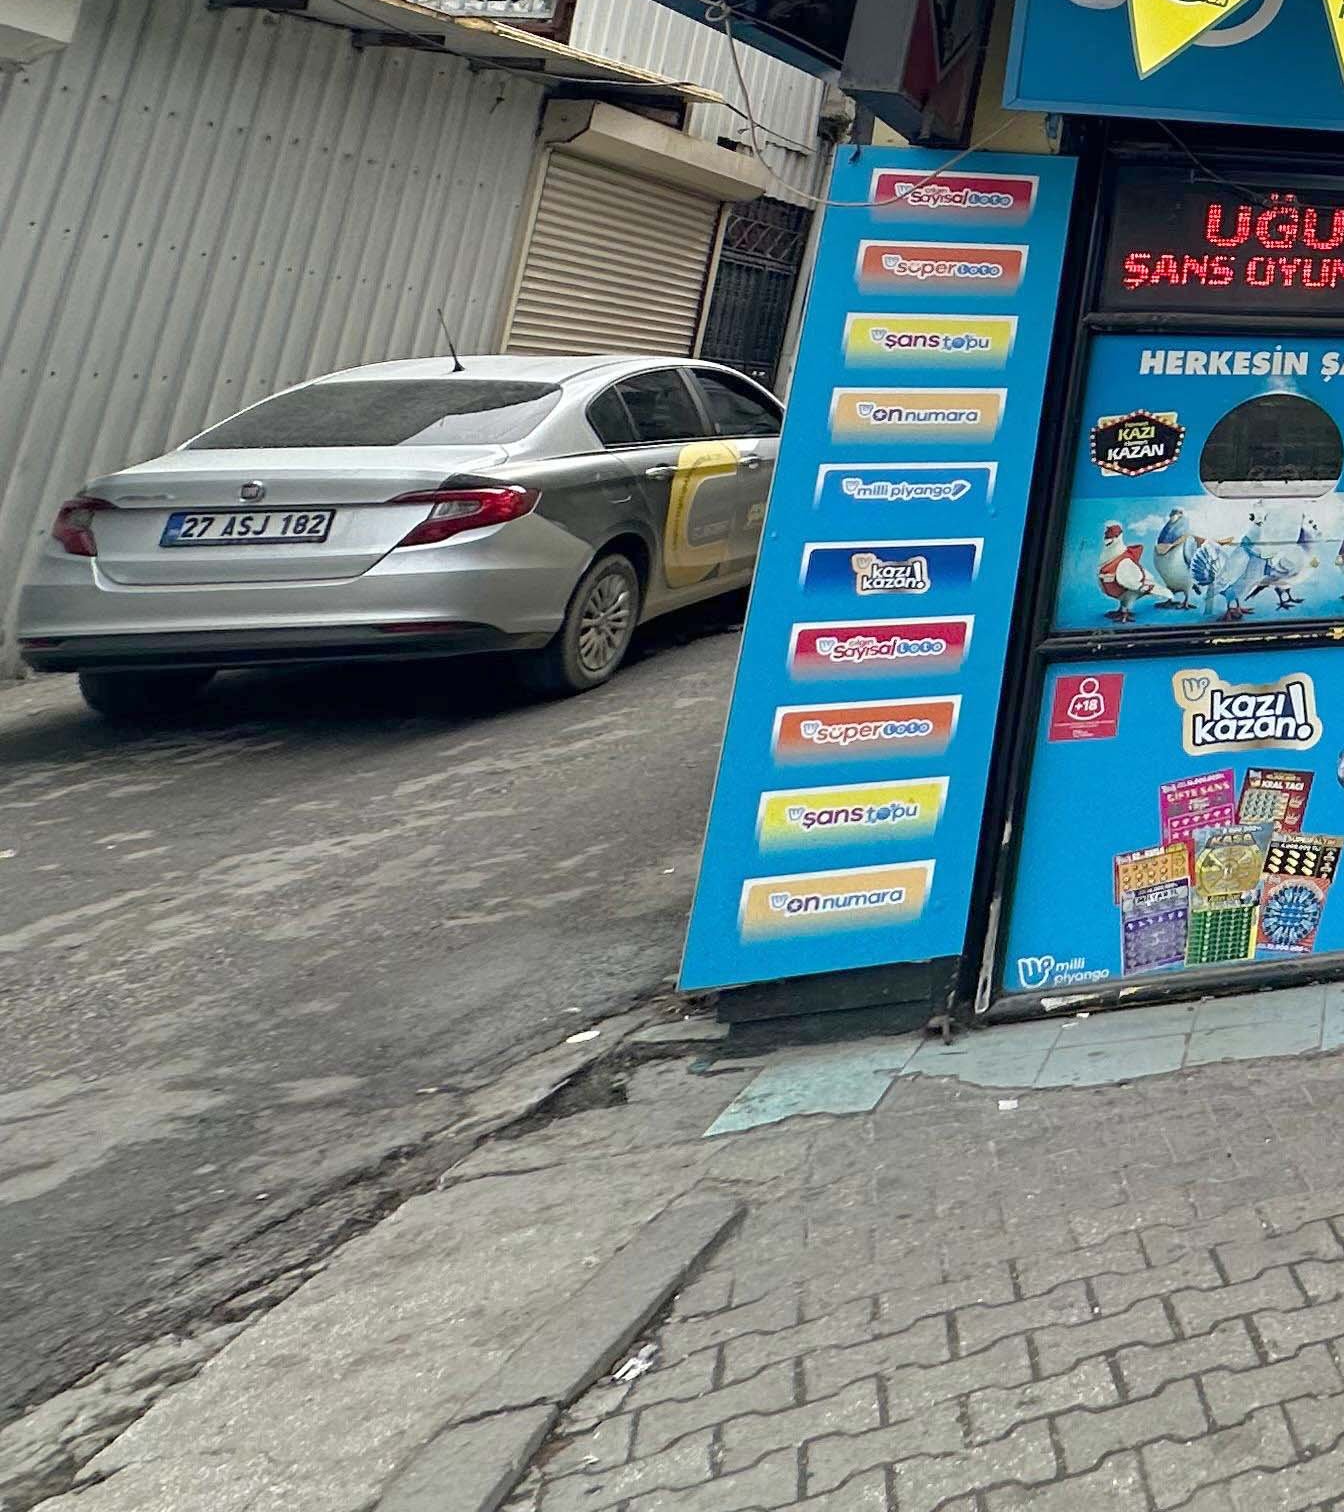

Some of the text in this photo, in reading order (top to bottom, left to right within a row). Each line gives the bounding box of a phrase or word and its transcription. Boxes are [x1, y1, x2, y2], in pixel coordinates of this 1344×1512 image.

[1123, 253, 1234, 289] ŞANS
[885, 332, 940, 352] şans
[1139, 345, 1308, 376] HERKESİN
[903, 409, 979, 422] numara
[1118, 425, 1155, 440] KAZI
[1107, 443, 1164, 461] KAZAN
[857, 483, 953, 499] milli piyango
[180, 514, 326, 537] 27 ASJ 182
[871, 562, 912, 578] kazı
[833, 637, 897, 659] Sayısal
[1075, 699, 1097, 711] +18
[1194, 682, 1314, 746] kazan!
[1211, 691, 1285, 722] kazı
[802, 807, 863, 829] şans
[786, 888, 903, 914] on numara
[1055, 958, 1085, 971] milli
[1053, 968, 1109, 986] piyango
